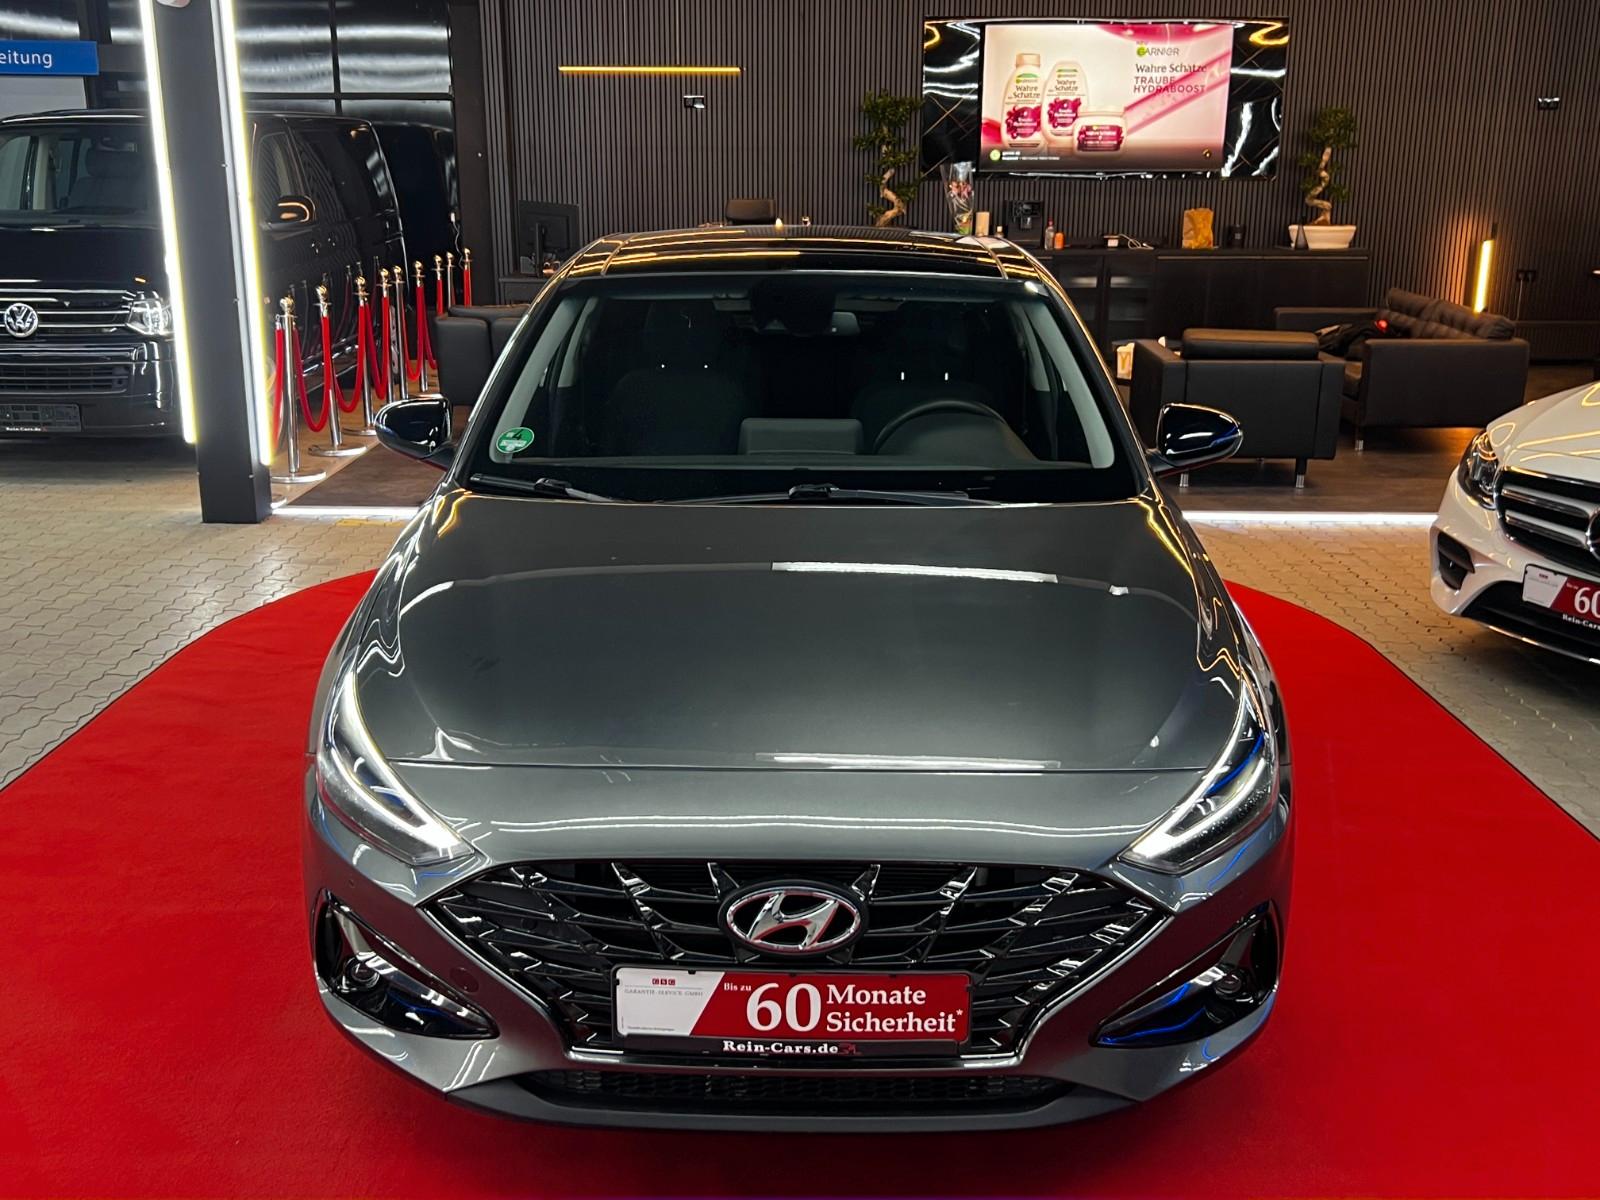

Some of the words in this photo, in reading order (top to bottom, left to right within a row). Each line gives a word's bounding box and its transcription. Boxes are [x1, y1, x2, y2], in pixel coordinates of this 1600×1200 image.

[1136, 46, 1180, 57] GARNIER
[0, 50, 53, 69] eitung
[1135, 63, 1167, 73] Wahre
[1134, 76, 1176, 85] TRAUBE
[1133, 85, 1206, 94] HYDRABOOST
[723, 982, 738, 991] Bis
[739, 984, 752, 992] zu
[826, 984, 927, 1006] Monate
[746, 982, 822, 1032] 60
[722, 1039, 839, 1054] Rein-Cars.de
